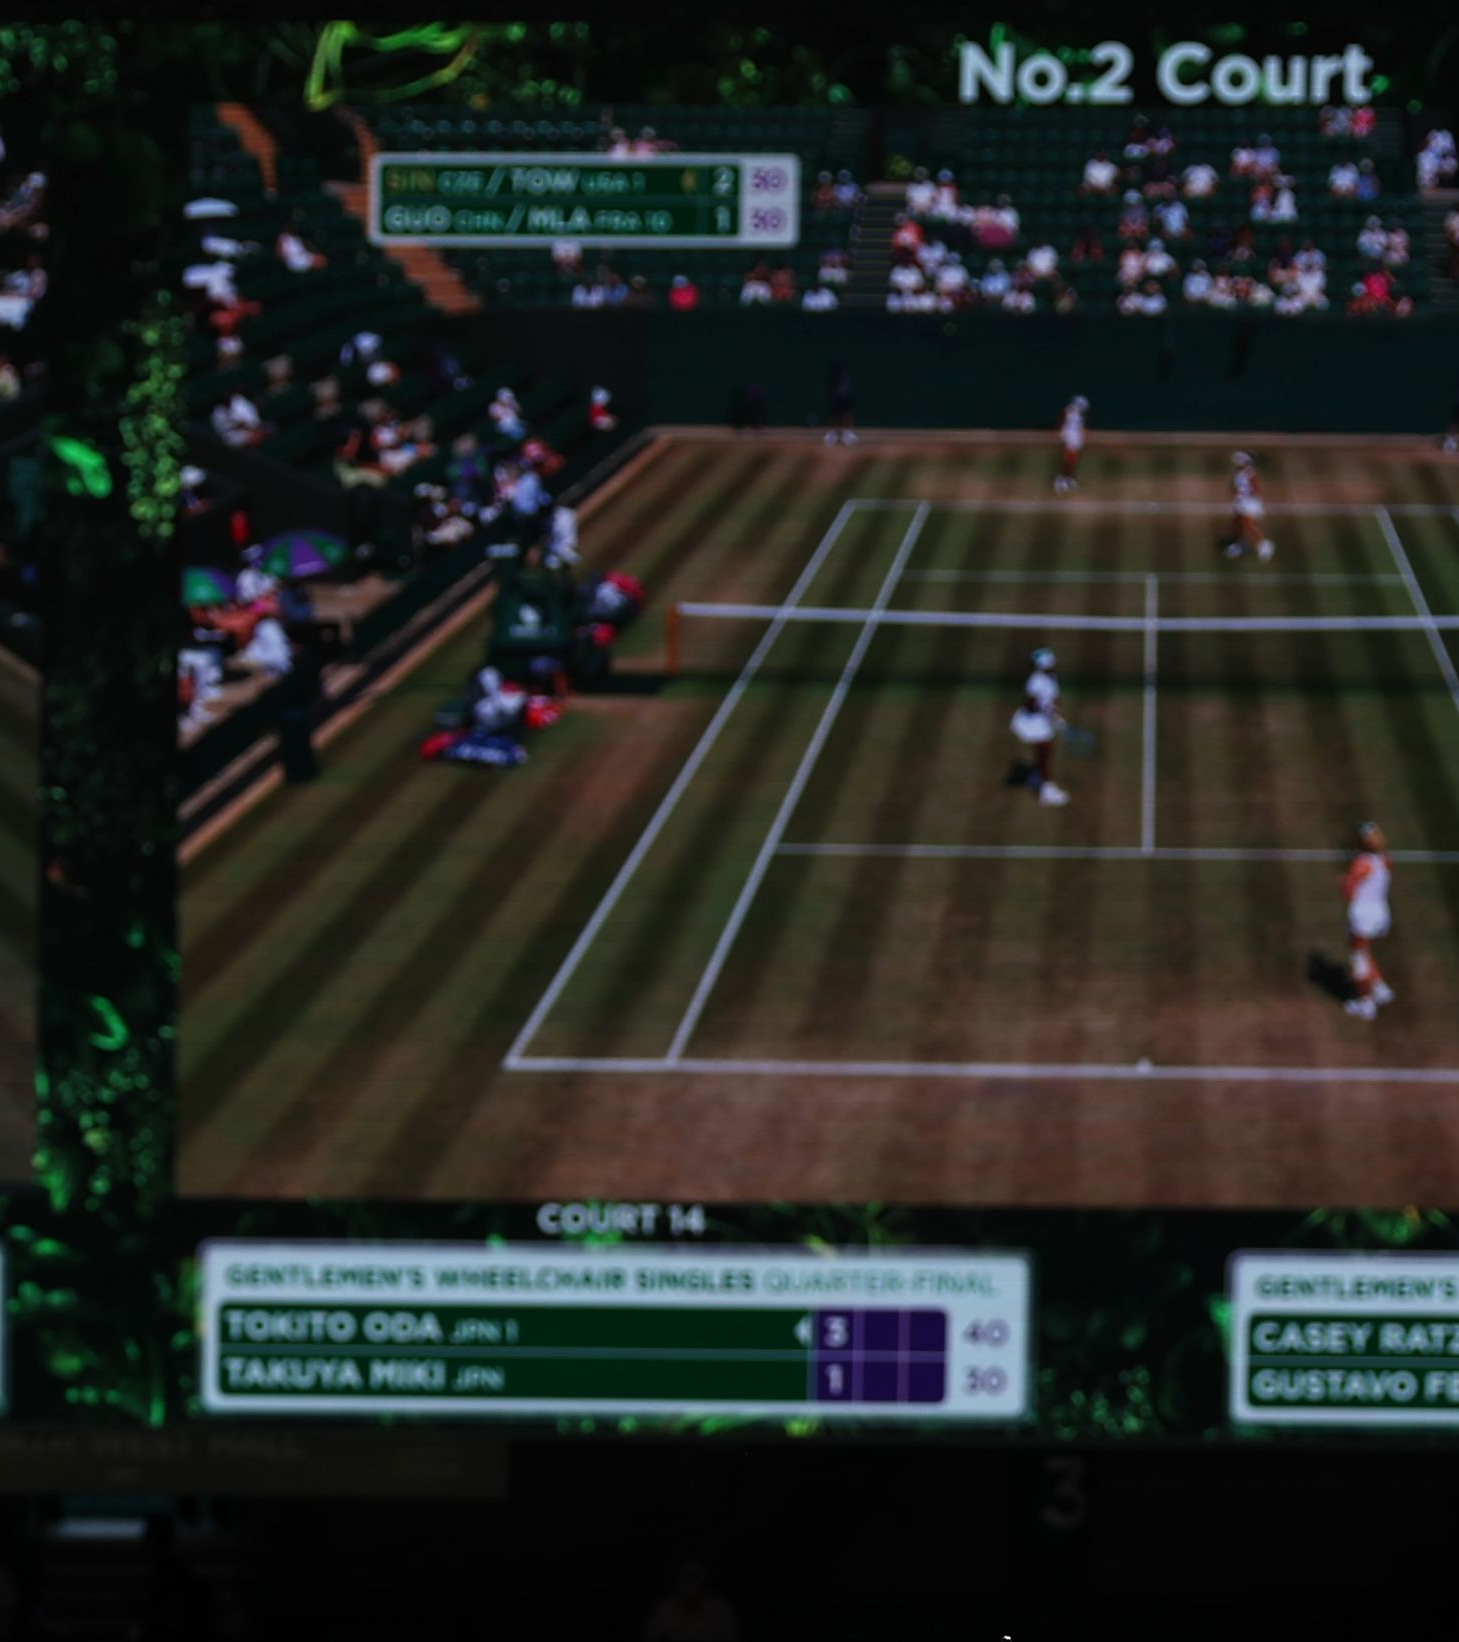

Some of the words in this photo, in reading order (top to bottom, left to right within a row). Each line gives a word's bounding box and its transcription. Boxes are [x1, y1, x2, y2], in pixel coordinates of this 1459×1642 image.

[959, 41, 1135, 105] No.2
[1156, 41, 1374, 105] Court
[510, 166, 579, 193] TOW
[712, 166, 736, 196] 2
[383, 204, 452, 233] GUO
[527, 204, 592, 233] MLA
[714, 204, 732, 233] 1
[536, 1202, 660, 1235] COURT
[667, 1204, 706, 1236] 14
[224, 1262, 426, 1291] GENTLEMEN'S
[433, 1264, 626, 1292] WHEELCHAIR
[636, 1267, 756, 1293] SINGLES
[763, 1268, 996, 1297] QUARTER-FINAL
[1253, 1273, 1457, 1301] GENTLEMEN'S
[224, 1310, 357, 1343] TOKITO
[362, 1311, 443, 1343] ODA
[450, 1318, 501, 1344] JPN
[504, 1319, 519, 1344] 1
[823, 1315, 849, 1349] 3
[962, 1318, 1011, 1349] 40
[1252, 1320, 1372, 1354] CASEY
[224, 1356, 362, 1390] TAKUYA
[368, 1358, 446, 1390] MIKI
[451, 1365, 505, 1391] JPN
[825, 1362, 845, 1396] 1
[963, 1365, 1009, 1397] 30
[1251, 1368, 1419, 1402] GUSTAVO
[1039, 1455, 1089, 1532] 3
